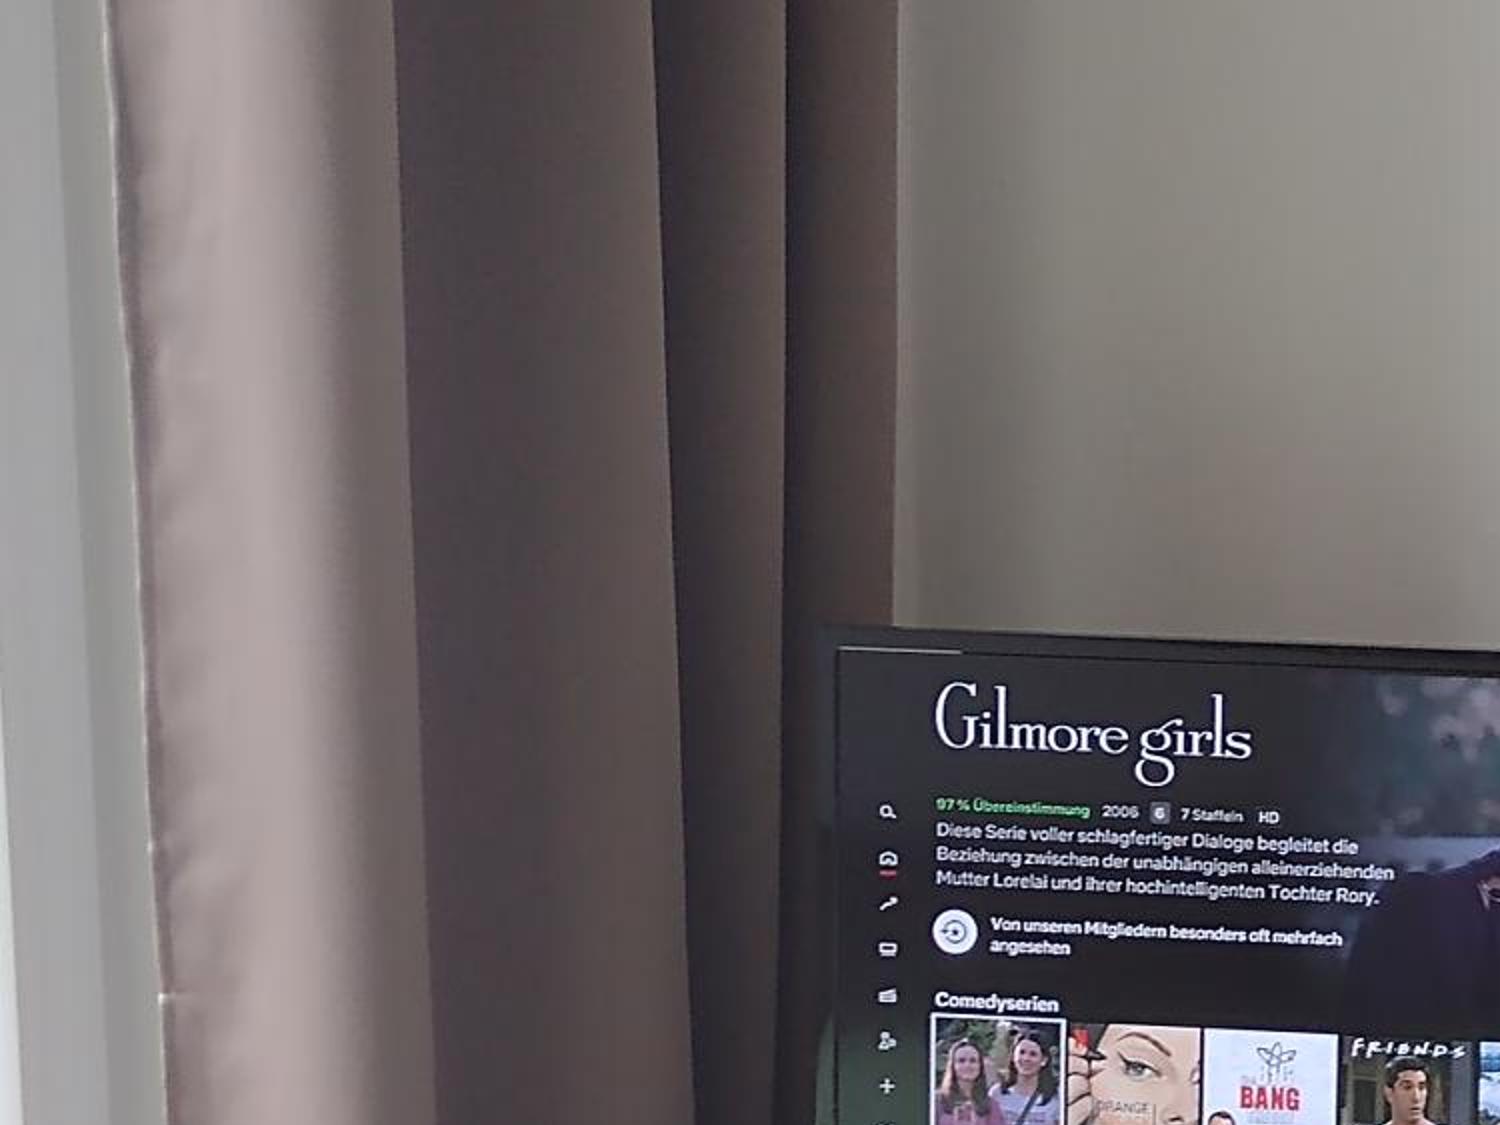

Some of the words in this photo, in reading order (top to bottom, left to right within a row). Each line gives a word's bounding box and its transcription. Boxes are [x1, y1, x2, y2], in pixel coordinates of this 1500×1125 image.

[934, 682, 1128, 755] Gilmore
[1134, 693, 1252, 787] girls
[973, 797, 1091, 818] Übereinstimmung
[1101, 805, 1139, 818] 2006
[1192, 808, 1244, 822] Staffeln
[1258, 811, 1280, 824] HD
[936, 822, 981, 839] Diese
[984, 824, 1027, 840] Serie
[1030, 826, 1074, 842] voller
[1077, 828, 1188, 850] schlagfertiger
[1191, 833, 1254, 853] Dialoge
[1257, 836, 1330, 855] begleitet
[1332, 838, 1359, 854] die
[936, 846, 1022, 868] Beziehung
[1024, 851, 1099, 868] zwischen
[1102, 854, 1129, 868] der
[1133, 855, 1248, 876] unabhängigen
[1251, 860, 1395, 880] alleinerziehenden
[936, 870, 990, 887] Mutter
[993, 873, 1048, 889] Lorelai
[1051, 876, 1082, 891] und
[1085, 876, 1122, 893] ihrer
[1125, 878, 1265, 900] hochintelligenten
[1268, 884, 1333, 901] Tochter
[1335, 887, 1380, 907] Rory.
[990, 917, 1020, 932] Von
[1023, 919, 1082, 934] unseren
[1084, 921, 1166, 940] Mitgliedern
[1169, 925, 1247, 942] besonders
[1249, 928, 1270, 943] oft
[1272, 929, 1343, 946] mehrfach
[990, 939, 1071, 956] angesehen
[935, 991, 1060, 1013] Comedyserien
[1239, 1085, 1301, 1111] BANG
